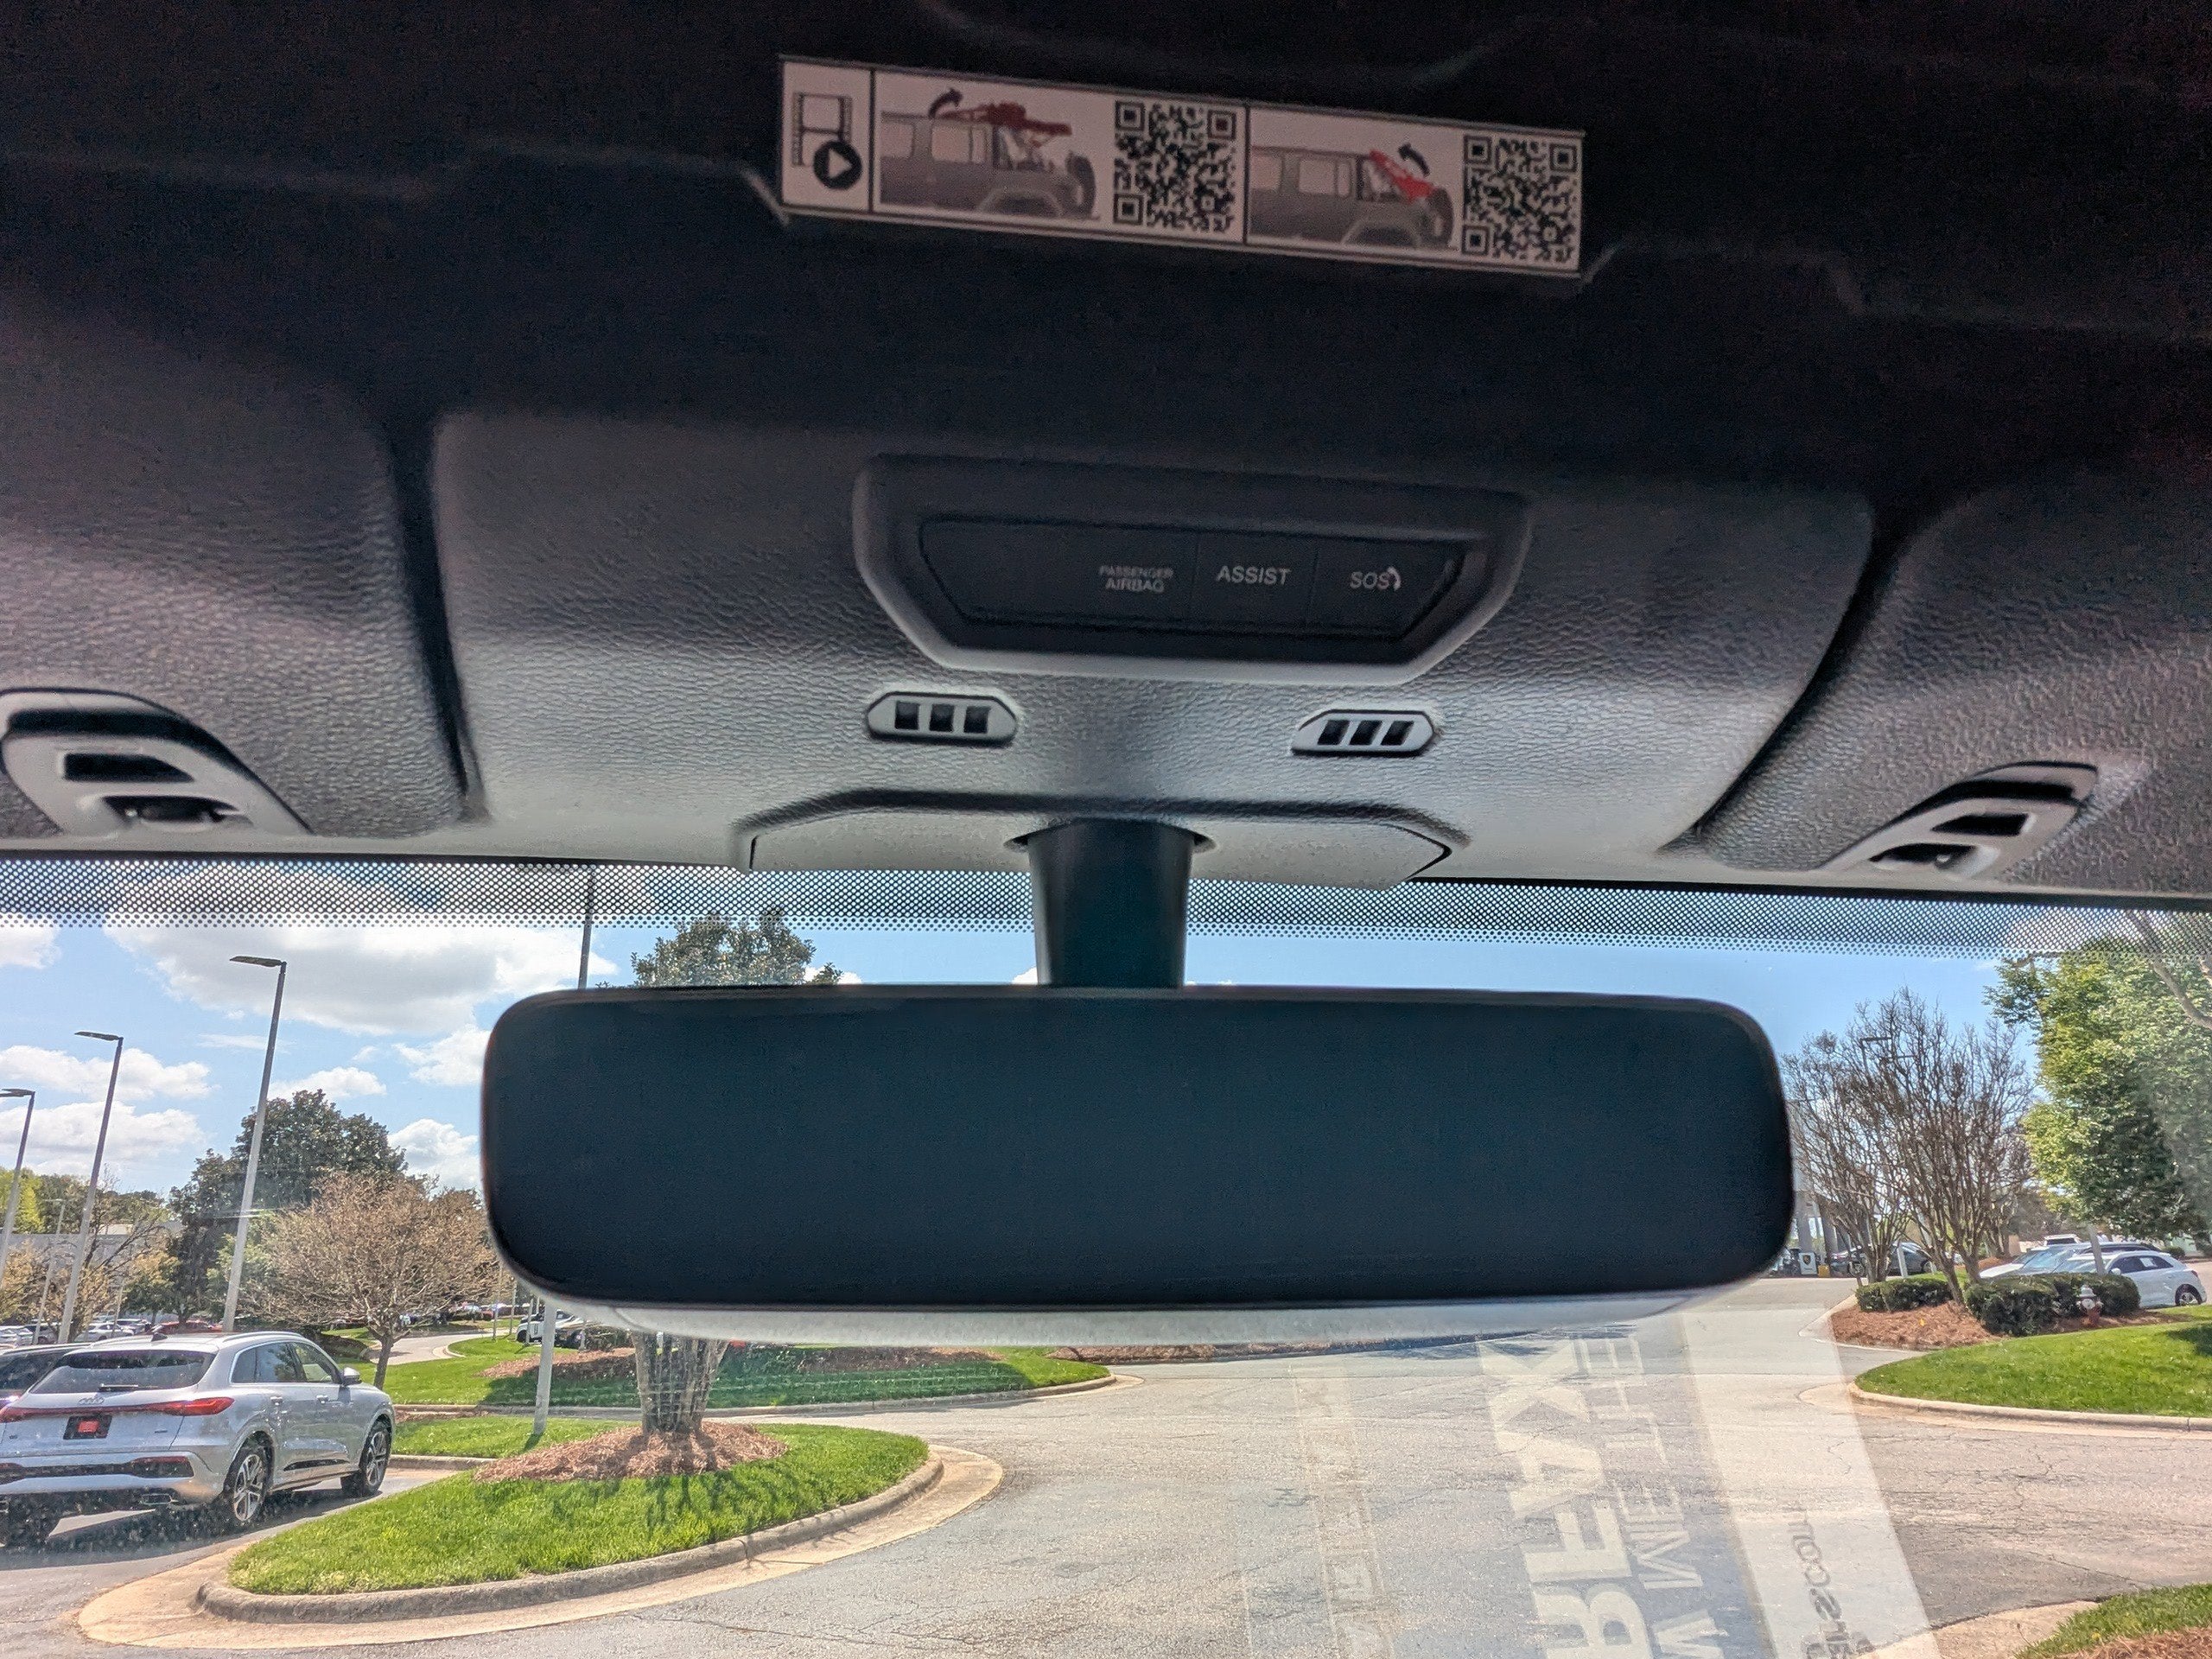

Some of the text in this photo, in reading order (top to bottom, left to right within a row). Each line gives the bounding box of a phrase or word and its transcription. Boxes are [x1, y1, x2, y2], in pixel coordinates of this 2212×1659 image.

[1105, 577, 1165, 593] AIRBAG
[1216, 565, 1292, 585] ASSIST
[1349, 570, 1390, 590] SOS
